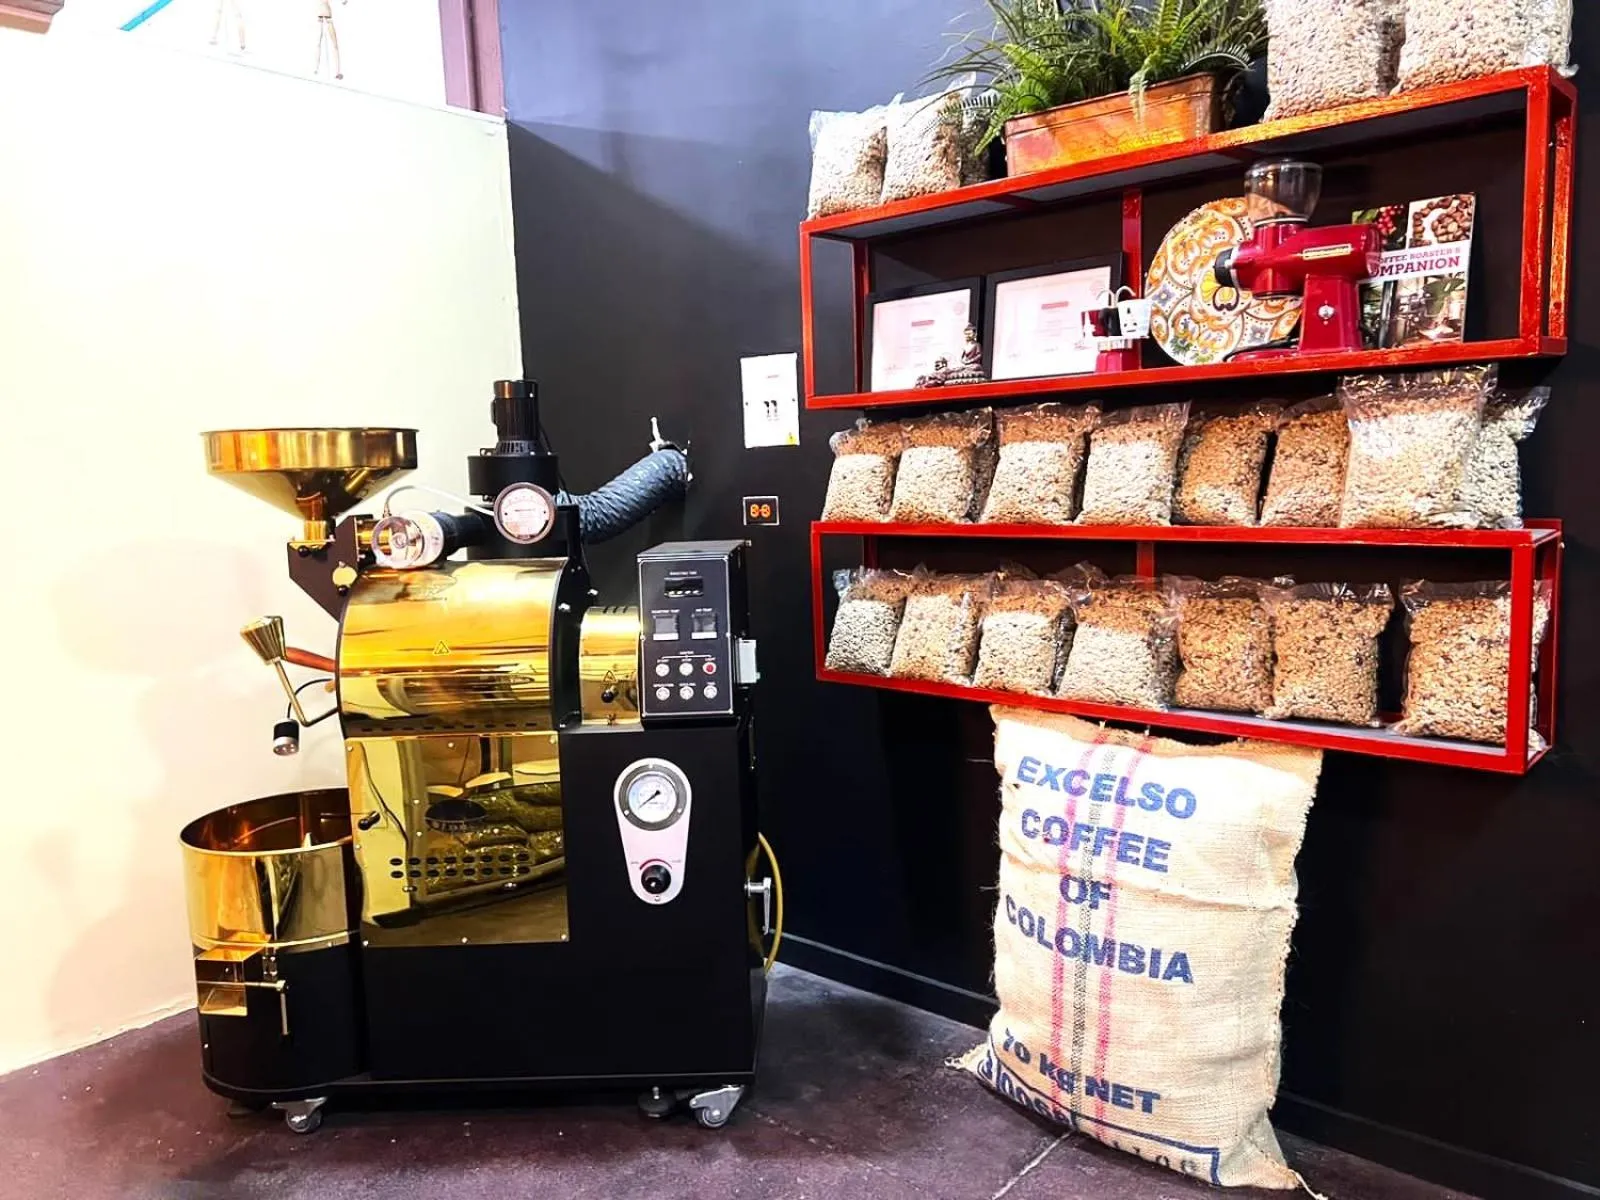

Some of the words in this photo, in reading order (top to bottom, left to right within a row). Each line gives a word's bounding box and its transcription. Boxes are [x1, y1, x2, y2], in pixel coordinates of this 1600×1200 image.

[1371, 256, 1460, 277] OMPANION
[1378, 254, 1408, 265] OFFEE
[1017, 756, 1197, 819] EXCELSO
[1021, 808, 1172, 873] COFFEE
[1059, 873, 1112, 910] OF
[1005, 894, 1194, 984] COLOMBIA
[1085, 1075, 1161, 1114] NET
